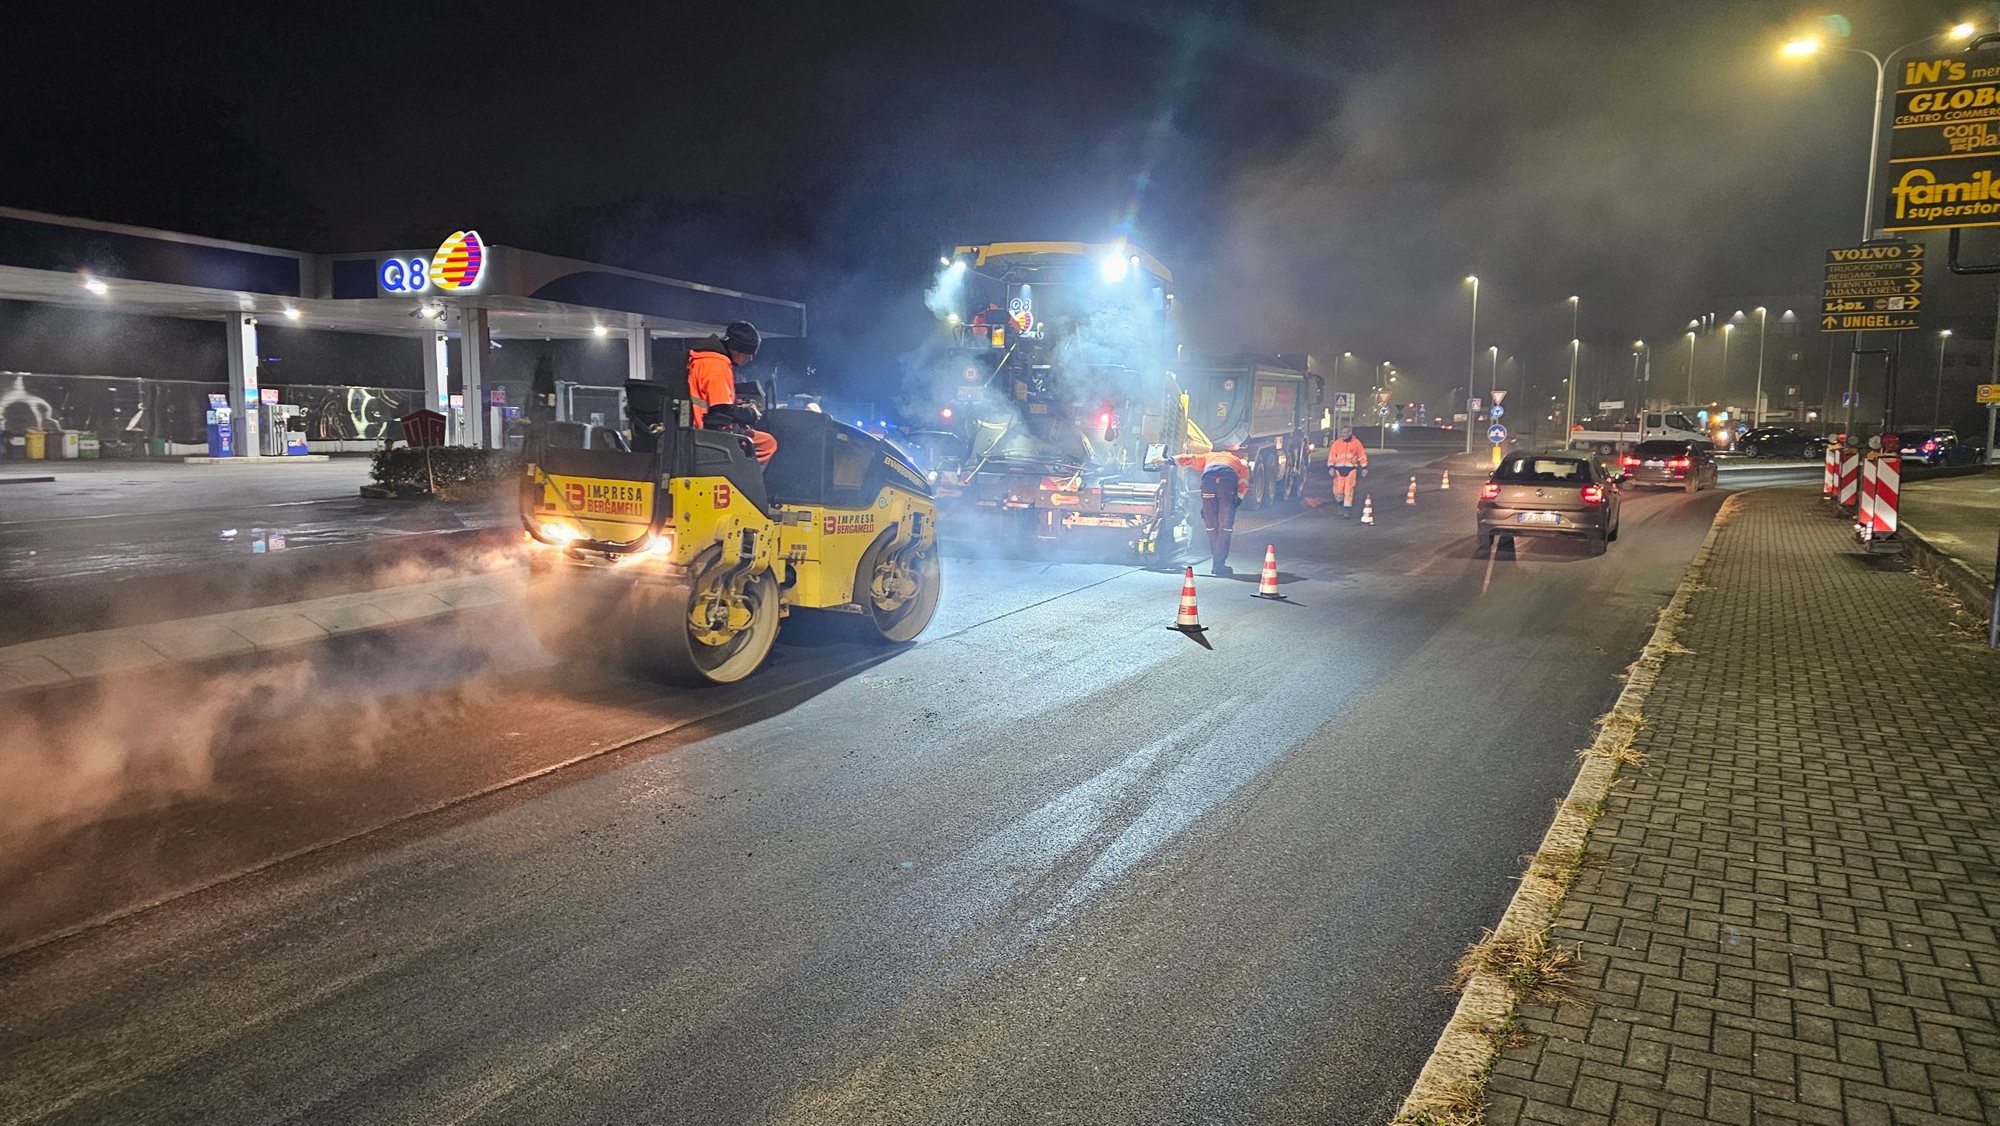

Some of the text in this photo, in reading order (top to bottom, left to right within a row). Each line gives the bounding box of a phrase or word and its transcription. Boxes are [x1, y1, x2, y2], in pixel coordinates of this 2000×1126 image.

[1909, 87, 2000, 113] GLOB
[1895, 113, 1942, 125] CENTRO
[1831, 246, 1901, 261] VOLVO
[1829, 262, 1902, 273] TRUCK CENTER
[381, 258, 425, 291] Q8
[1828, 271, 1876, 280] BERGAMO
[1831, 279, 1896, 289] VERNICIATURA
[1825, 287, 1864, 296] PADANA
[1010, 298, 1032, 312] Q8
[1842, 315, 1892, 328] UNIGEL
[587, 484, 643, 502] IMPRESA
[587, 500, 643, 517] BERGAMELLI
[837, 514, 875, 525] IMPRESA
[836, 523, 875, 535] BERGAMELLI
